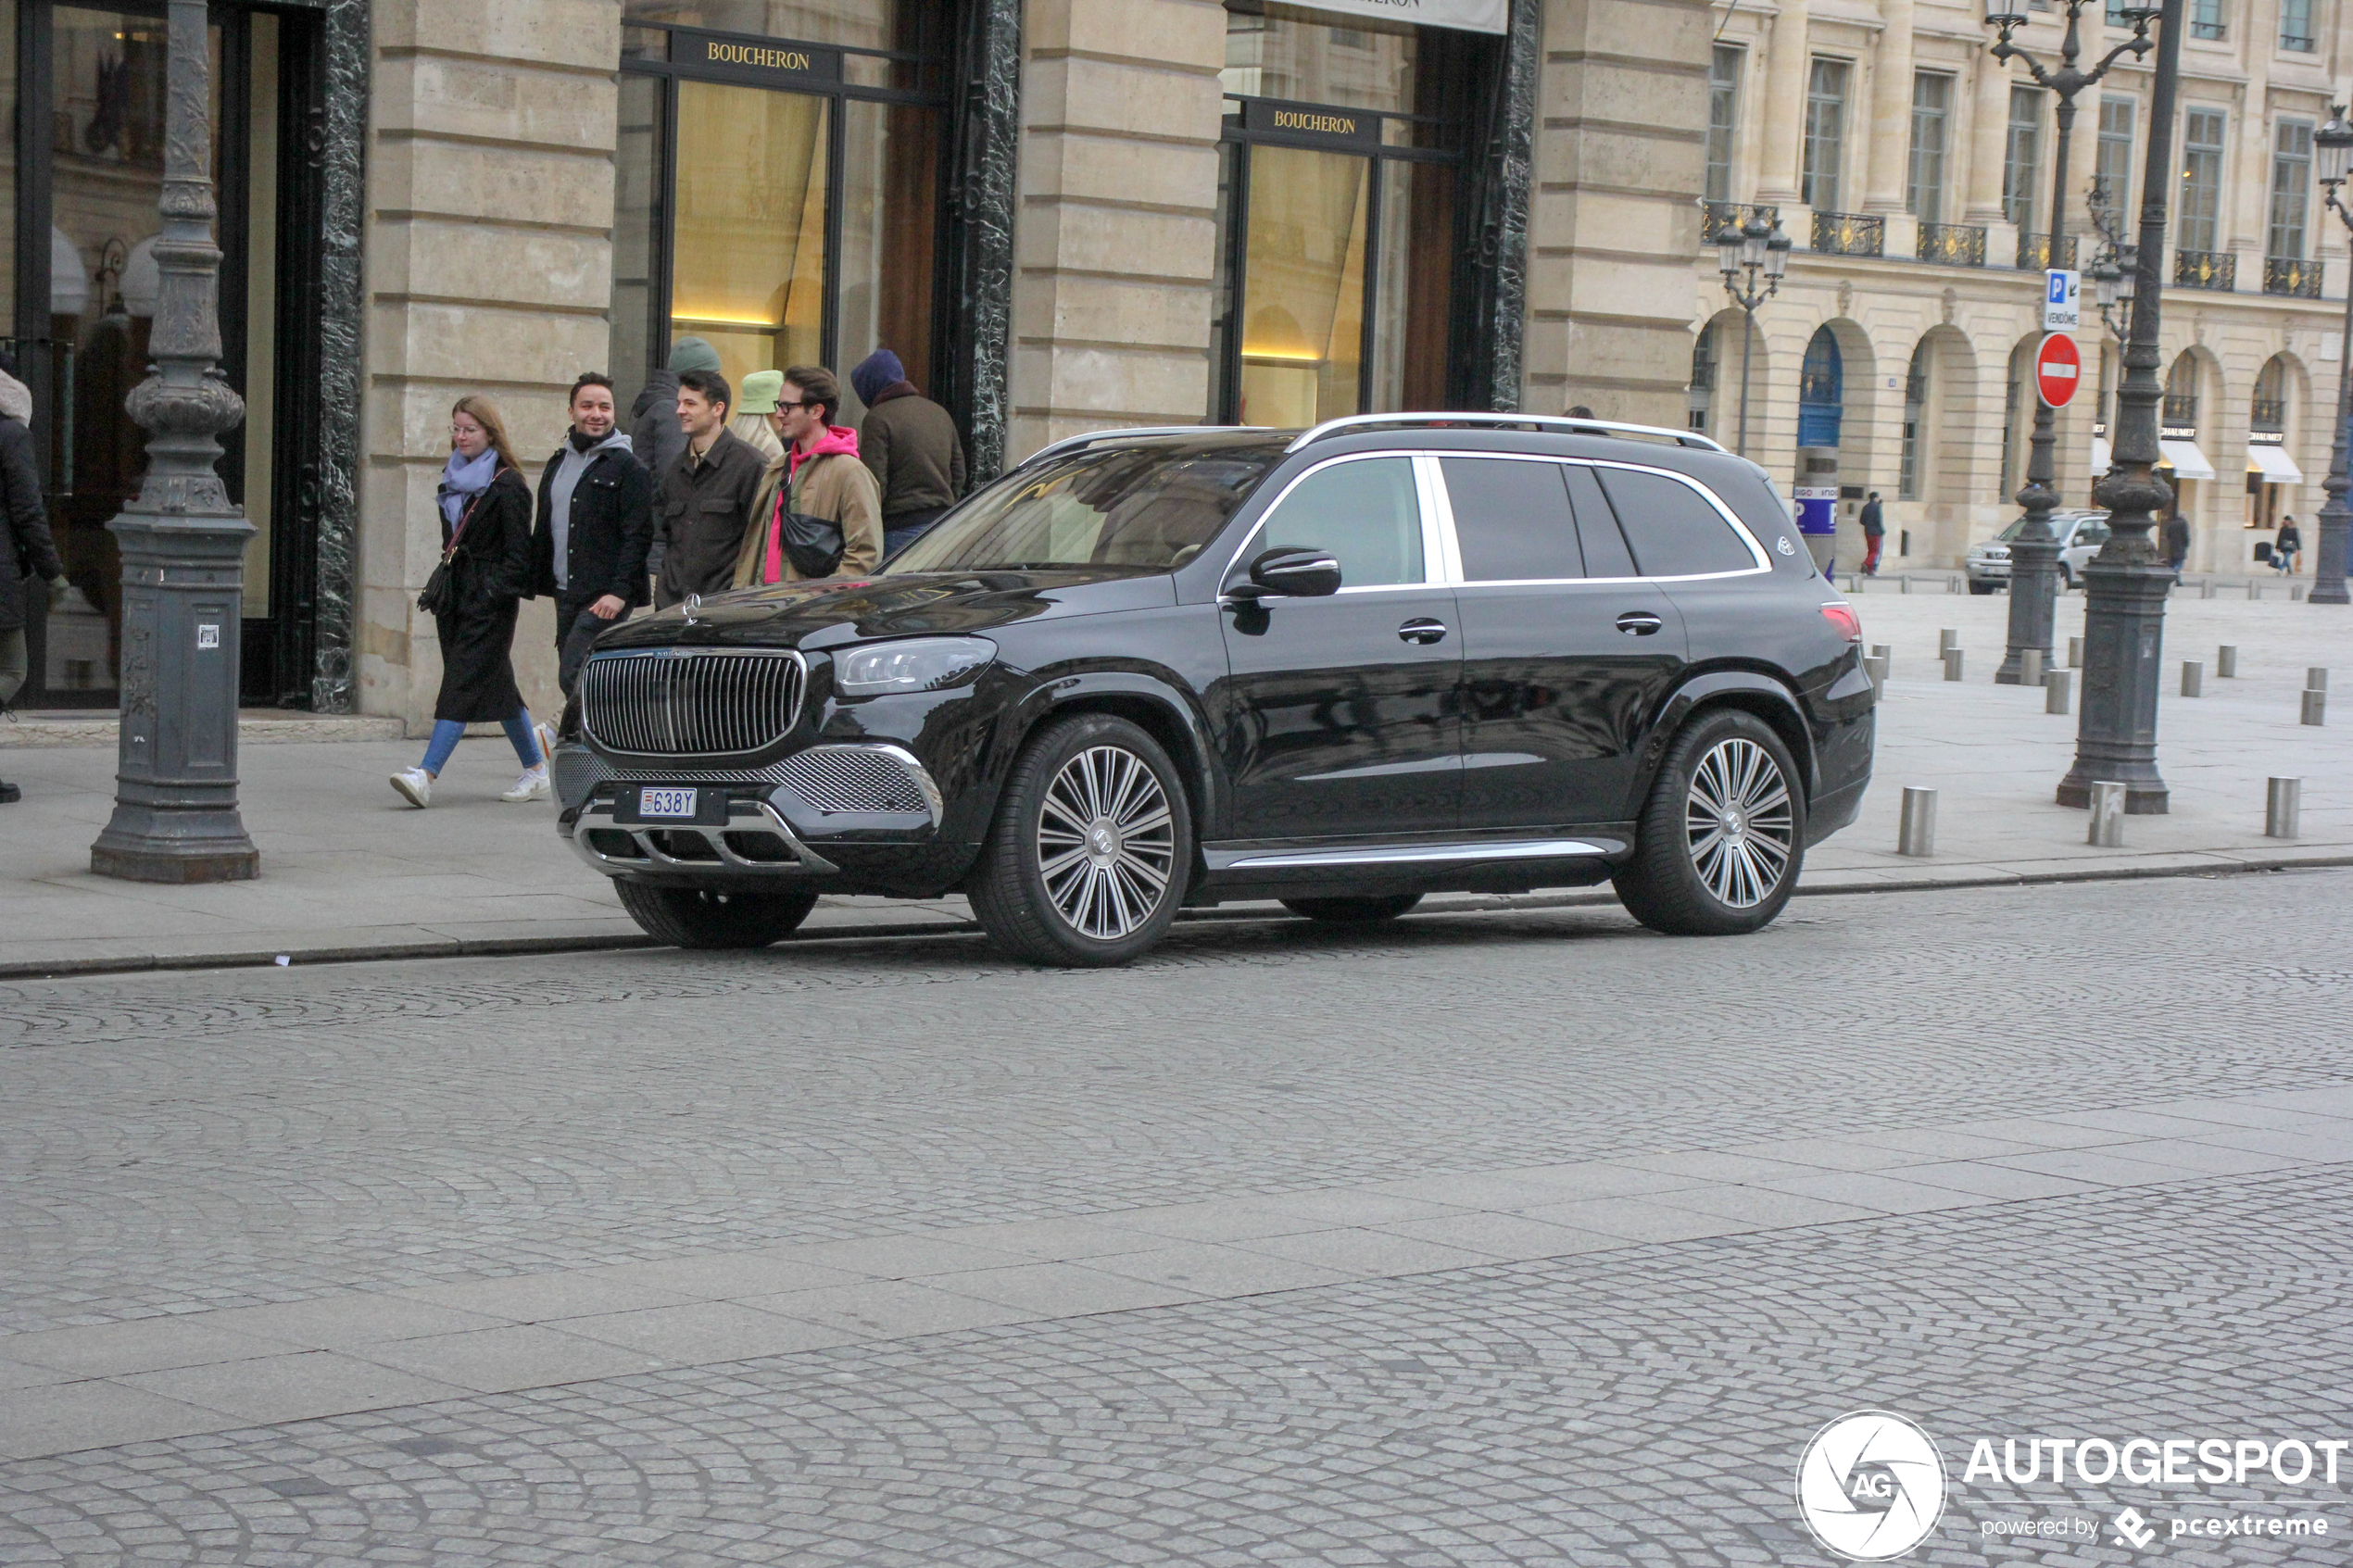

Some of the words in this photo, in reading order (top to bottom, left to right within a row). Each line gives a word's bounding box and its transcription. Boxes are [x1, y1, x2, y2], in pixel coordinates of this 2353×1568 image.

[708, 42, 810, 70] BOUCHERON
[1274, 110, 1355, 133] BOUCHERON
[2053, 278, 2063, 298] P
[2047, 311, 2078, 325] VENDÔME
[2248, 432, 2284, 442] CHAUMET
[654, 792, 693, 813] 638Y
